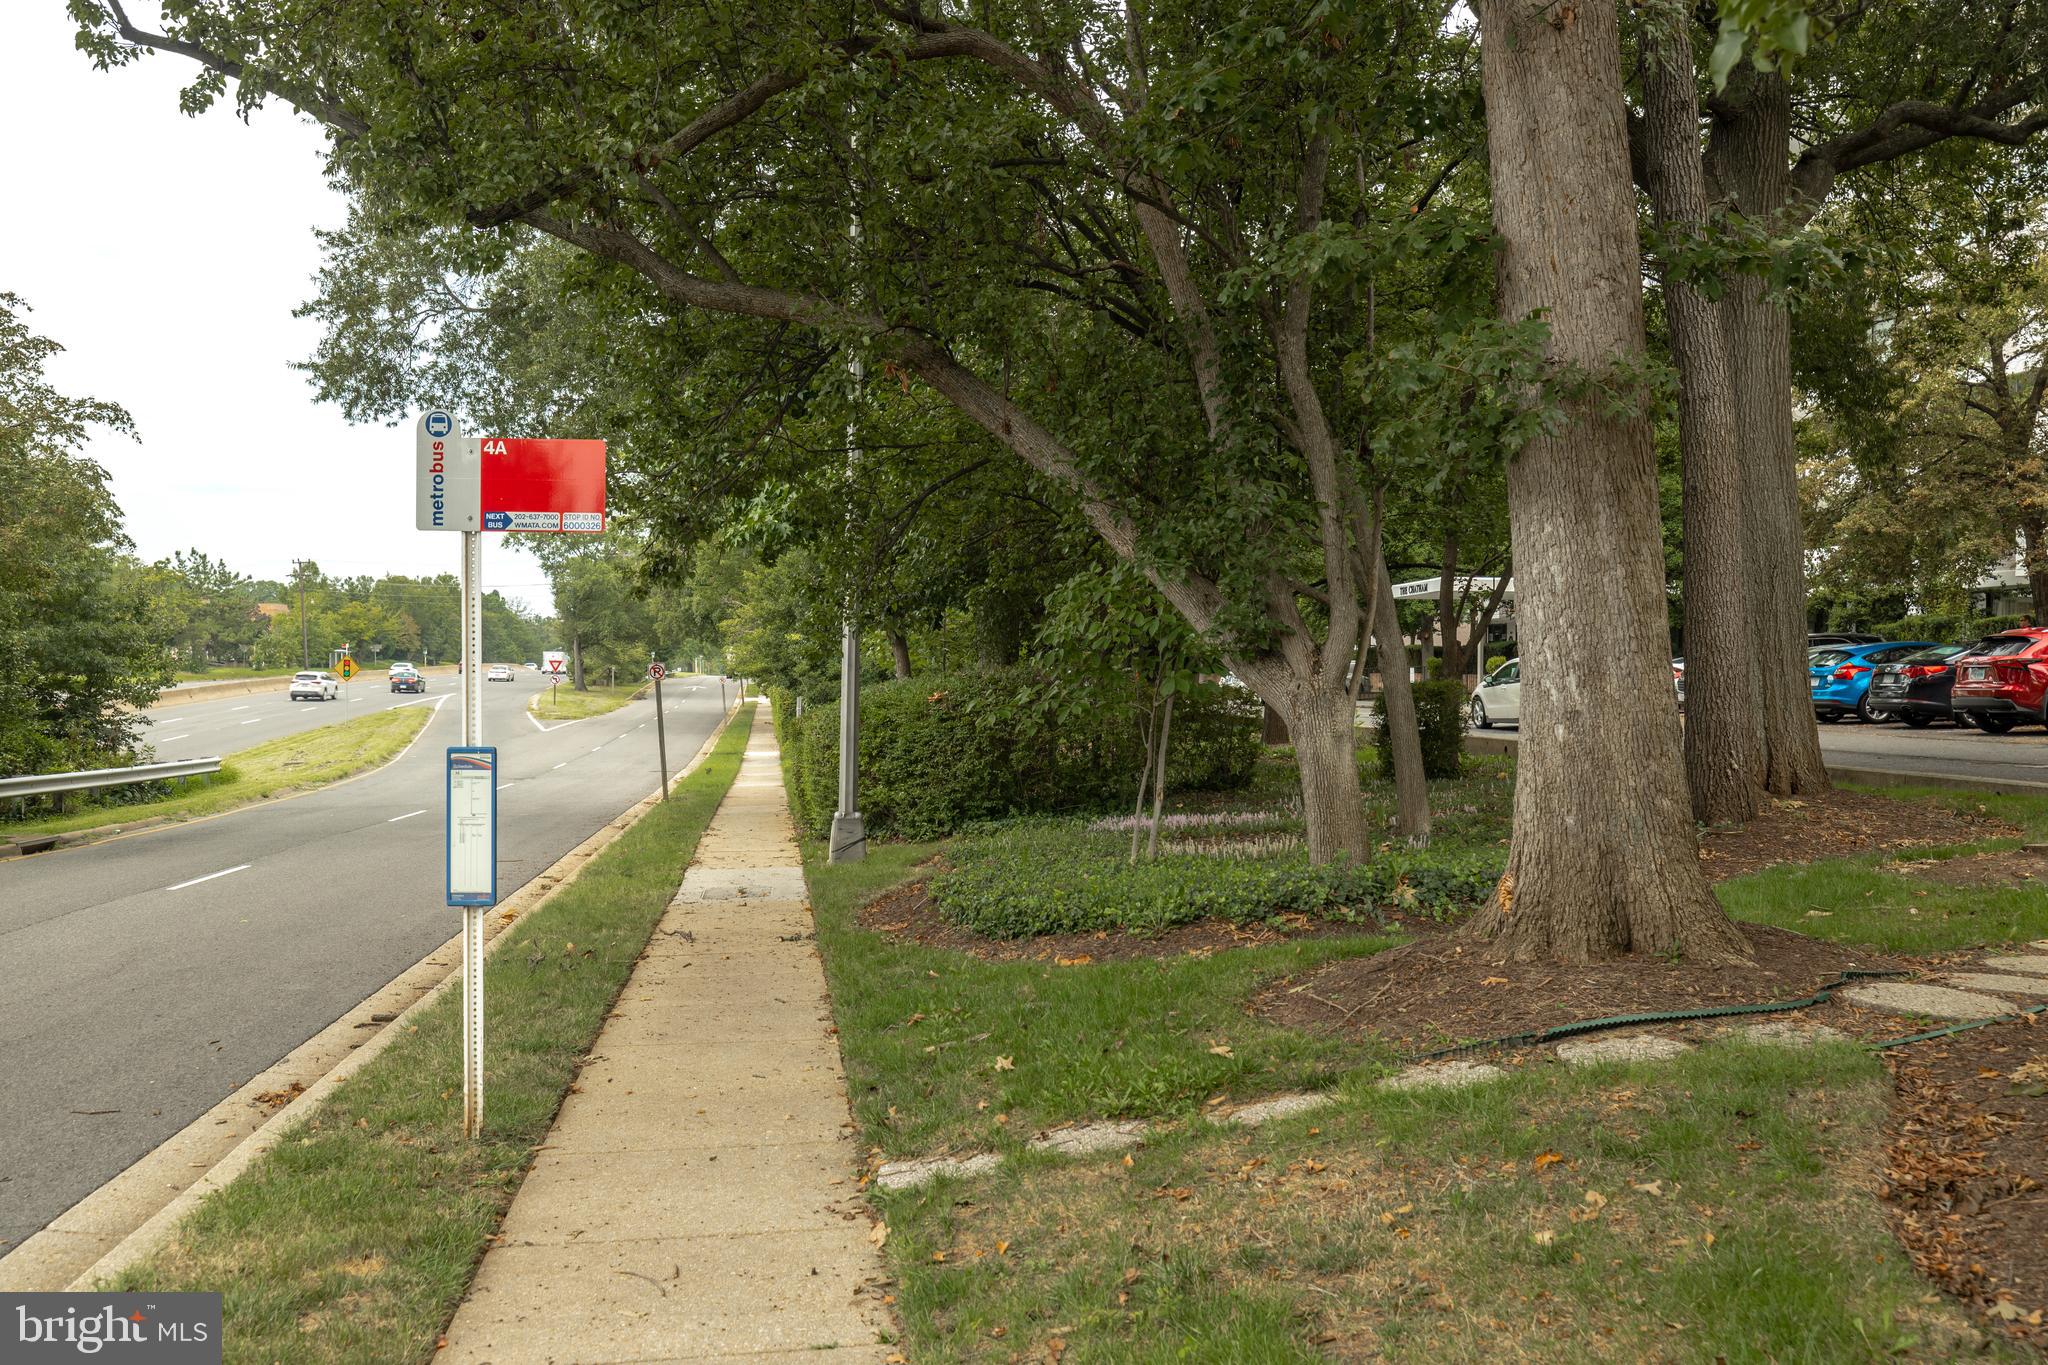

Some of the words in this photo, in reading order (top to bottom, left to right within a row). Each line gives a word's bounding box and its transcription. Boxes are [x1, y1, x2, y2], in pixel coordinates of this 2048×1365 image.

[483, 440, 507, 455] 4A
[429, 441, 444, 526] metrobus
[563, 521, 601, 530] 6000326
[1400, 587, 1408, 595] THE
[1409, 584, 1428, 593] CHATHAM
